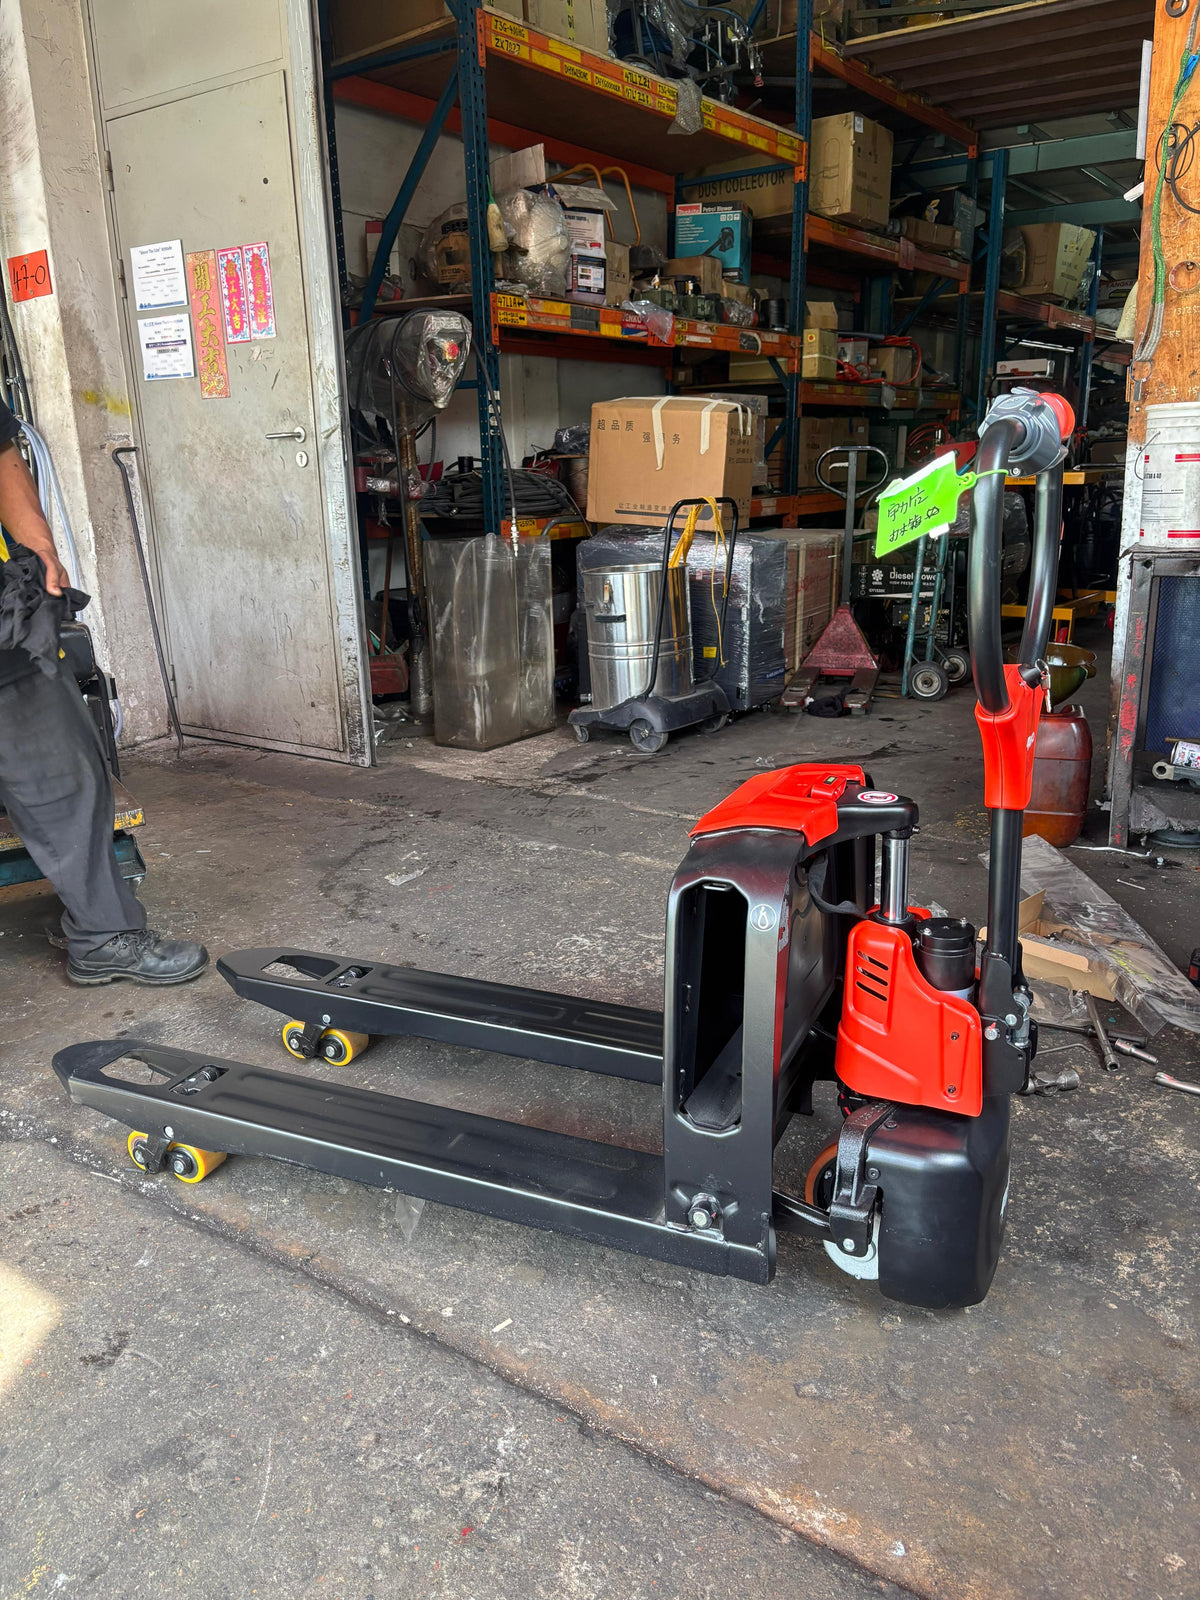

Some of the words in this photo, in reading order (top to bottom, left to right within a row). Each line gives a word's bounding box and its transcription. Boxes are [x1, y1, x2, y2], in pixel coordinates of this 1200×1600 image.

[725, 170, 785, 194] COLLECTOR
[194, 262, 219, 375] 開工大吉
[597, 419, 634, 432] 超品质
[642, 431, 681, 445] 强务
[889, 566, 914, 580] Diesel
